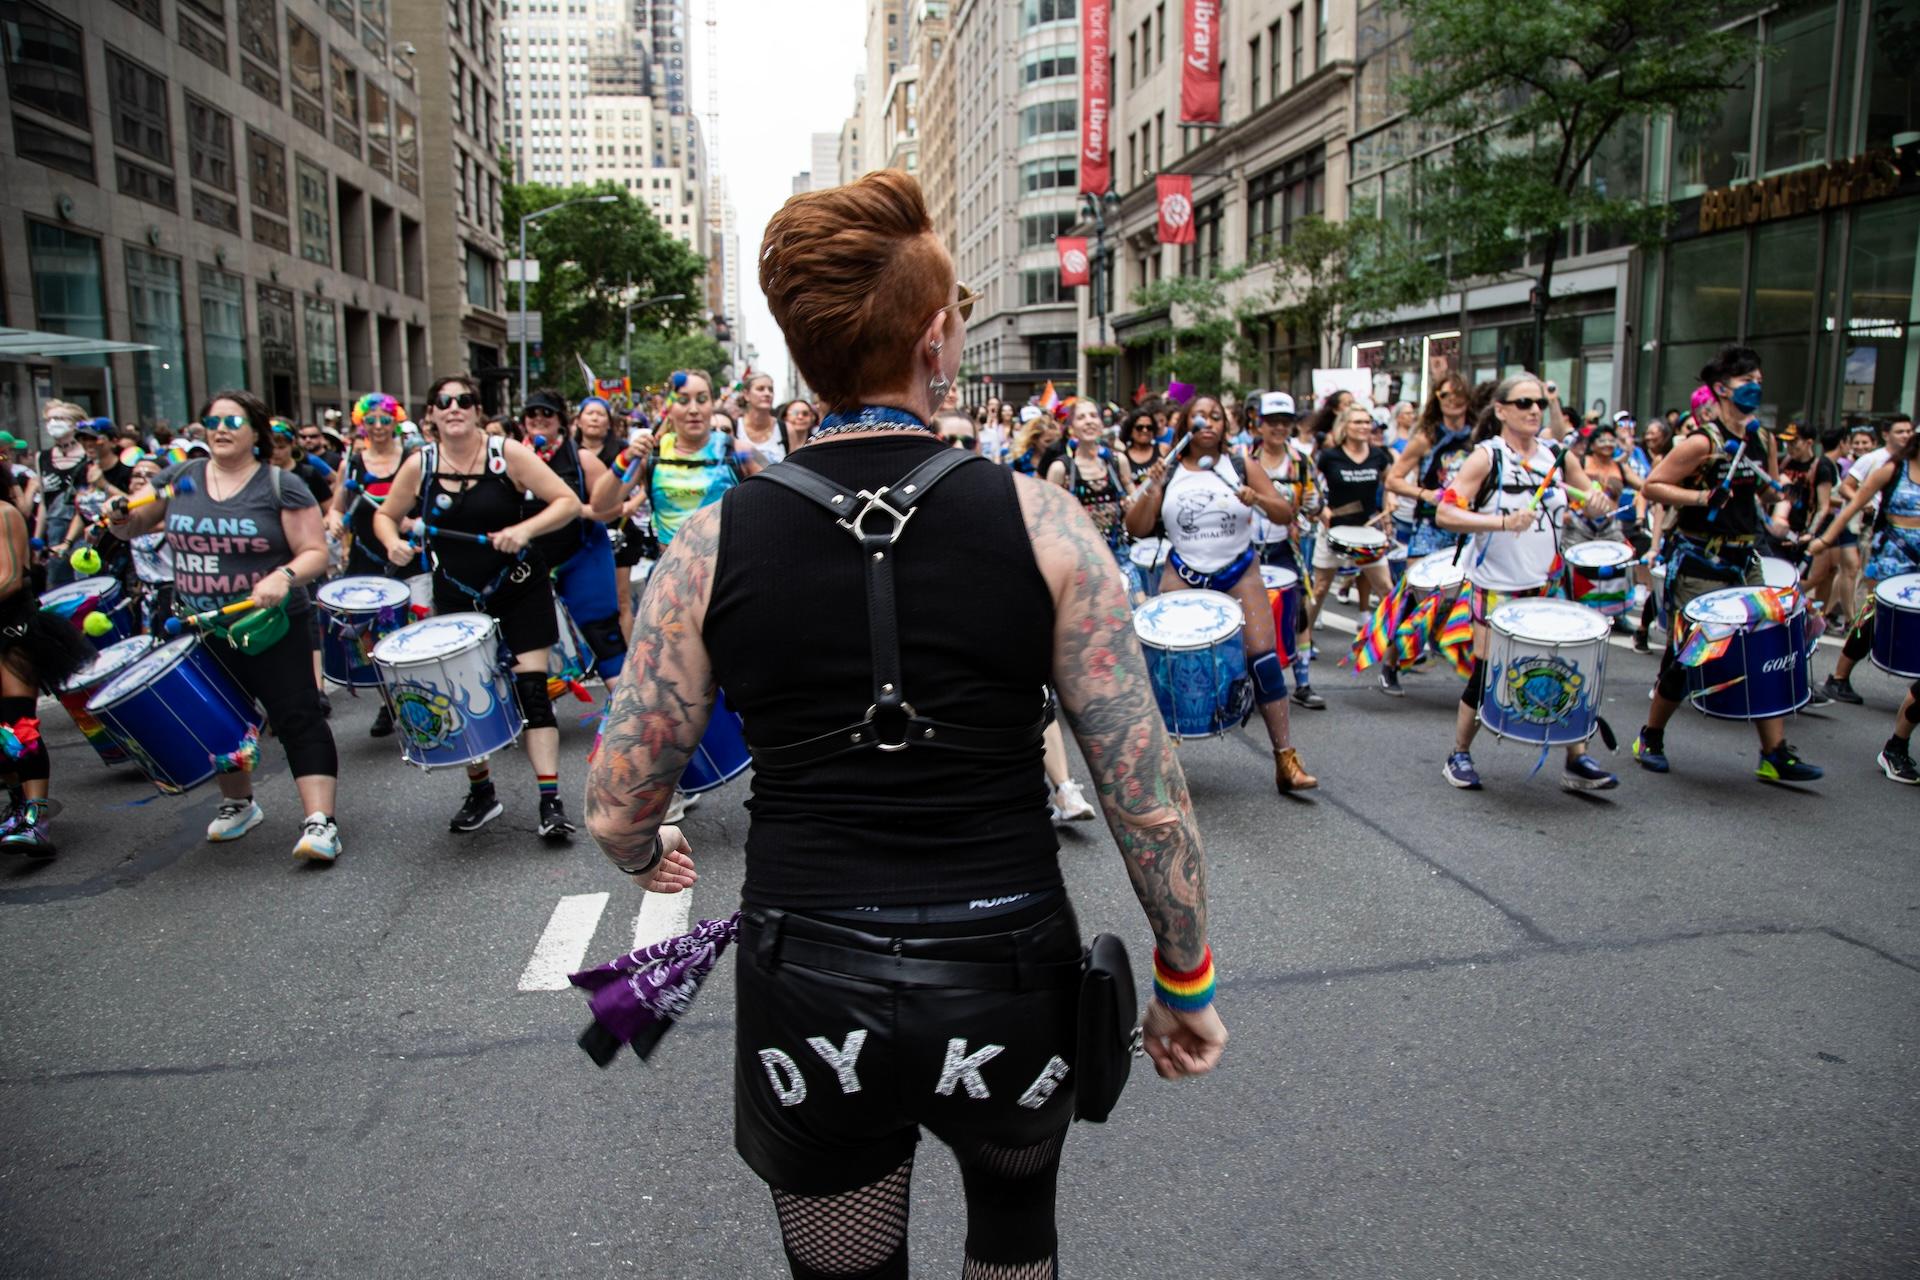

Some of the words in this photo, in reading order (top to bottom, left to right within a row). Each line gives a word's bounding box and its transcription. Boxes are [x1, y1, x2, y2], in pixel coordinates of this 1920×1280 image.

[1089, 4, 1107, 39] York
[1187, 0, 1215, 72] ibrary
[1090, 45, 1107, 91] Public
[1085, 98, 1107, 162] Library
[169, 514, 258, 536] TRANS
[1498, 505, 1566, 533] YC
[167, 532, 270, 554] RIGHTS
[176, 552, 220, 574] ARE
[757, 1028, 1070, 1110] DYKE
